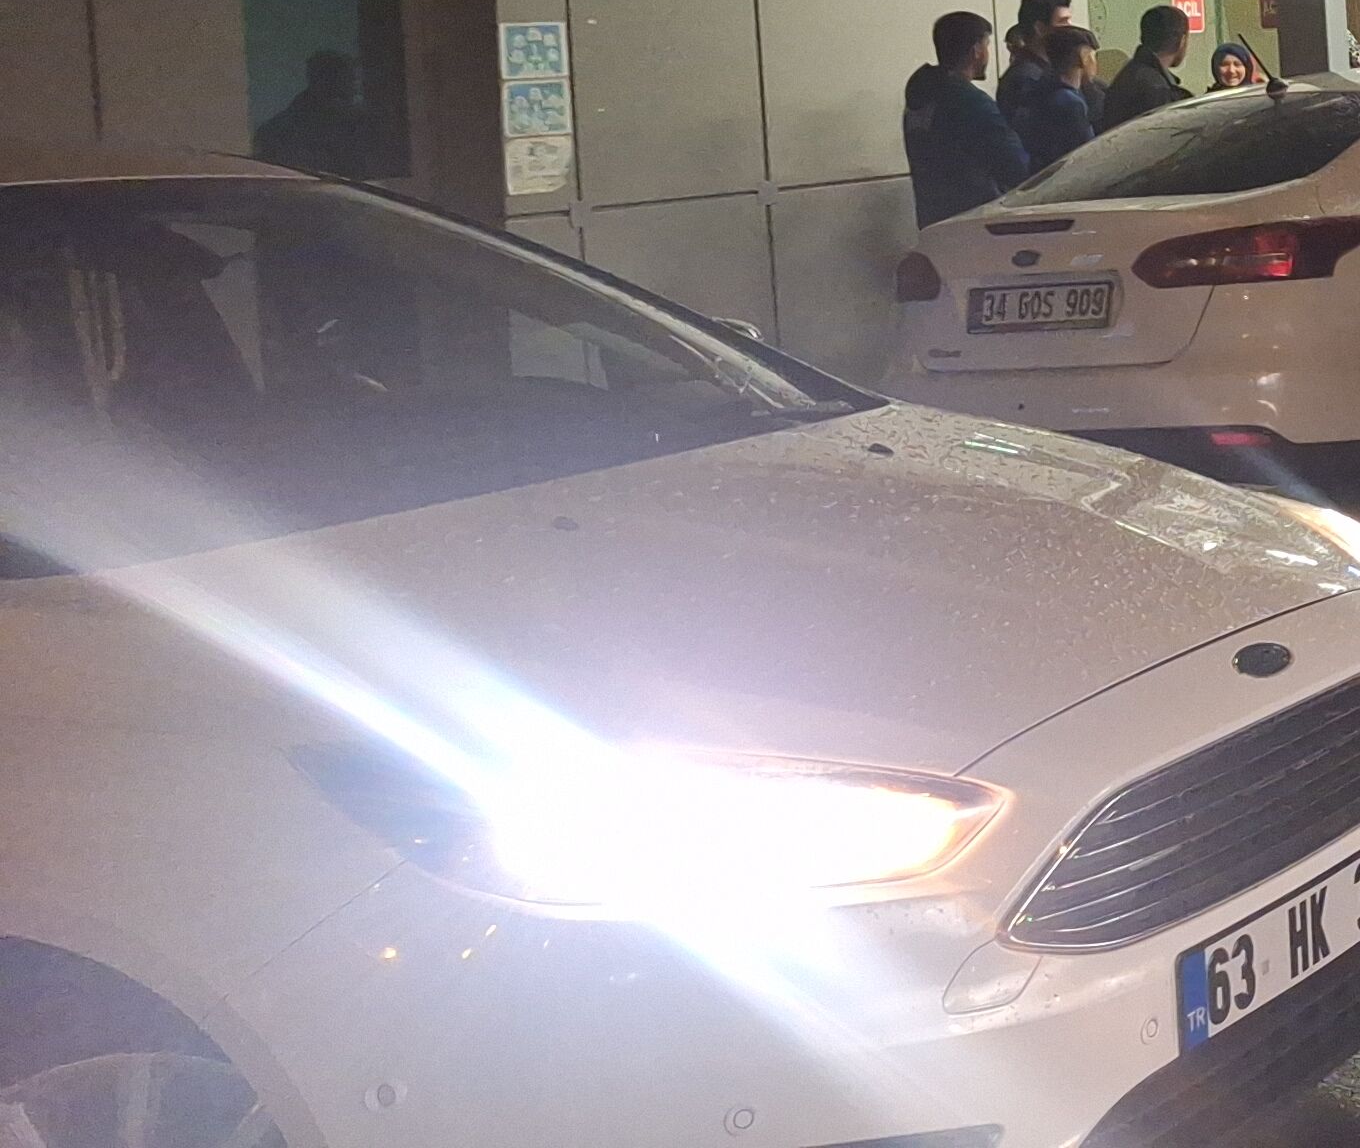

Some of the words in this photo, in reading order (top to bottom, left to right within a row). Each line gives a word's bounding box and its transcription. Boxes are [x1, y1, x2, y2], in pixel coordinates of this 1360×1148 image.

[983, 293, 1007, 322] 34
[1065, 288, 1104, 318] 909
[1207, 933, 1256, 1026] 63
[1287, 885, 1331, 980] HK
[1187, 1006, 1206, 1032] TR
